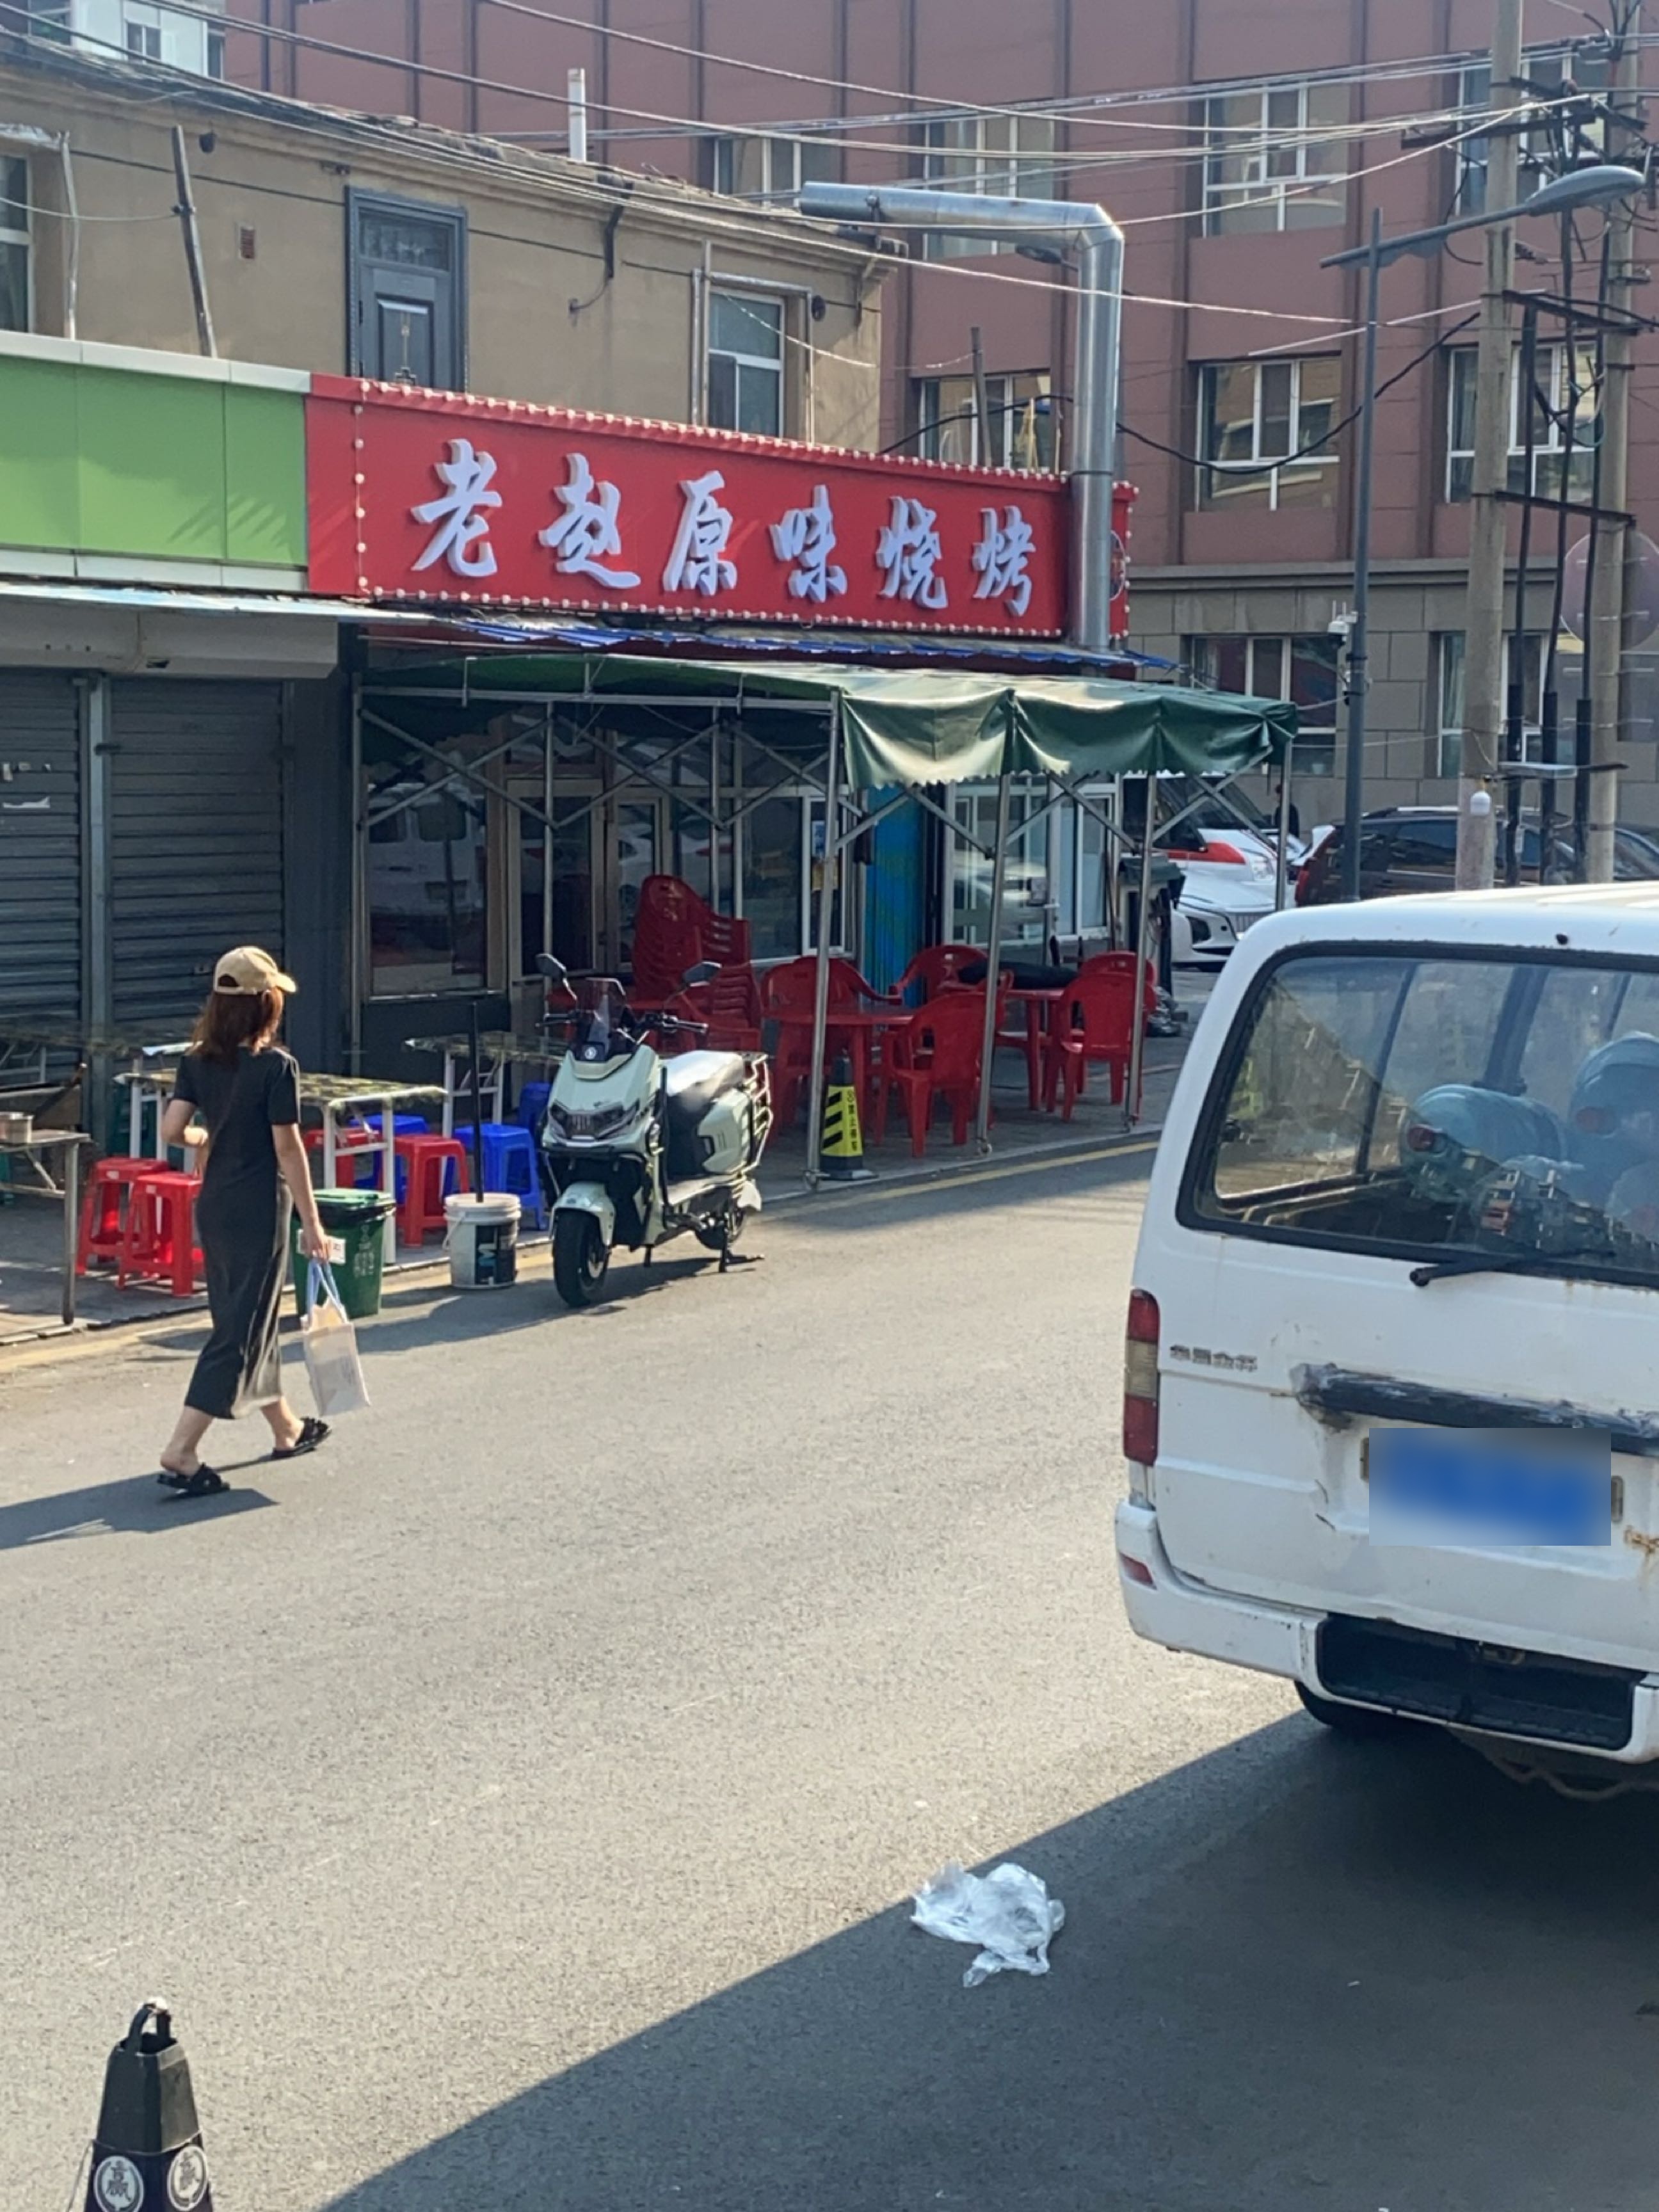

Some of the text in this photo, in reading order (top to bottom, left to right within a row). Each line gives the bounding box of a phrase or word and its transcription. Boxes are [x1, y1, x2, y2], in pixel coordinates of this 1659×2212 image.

[411, 438, 1037, 617] 老赵原味烧烤
